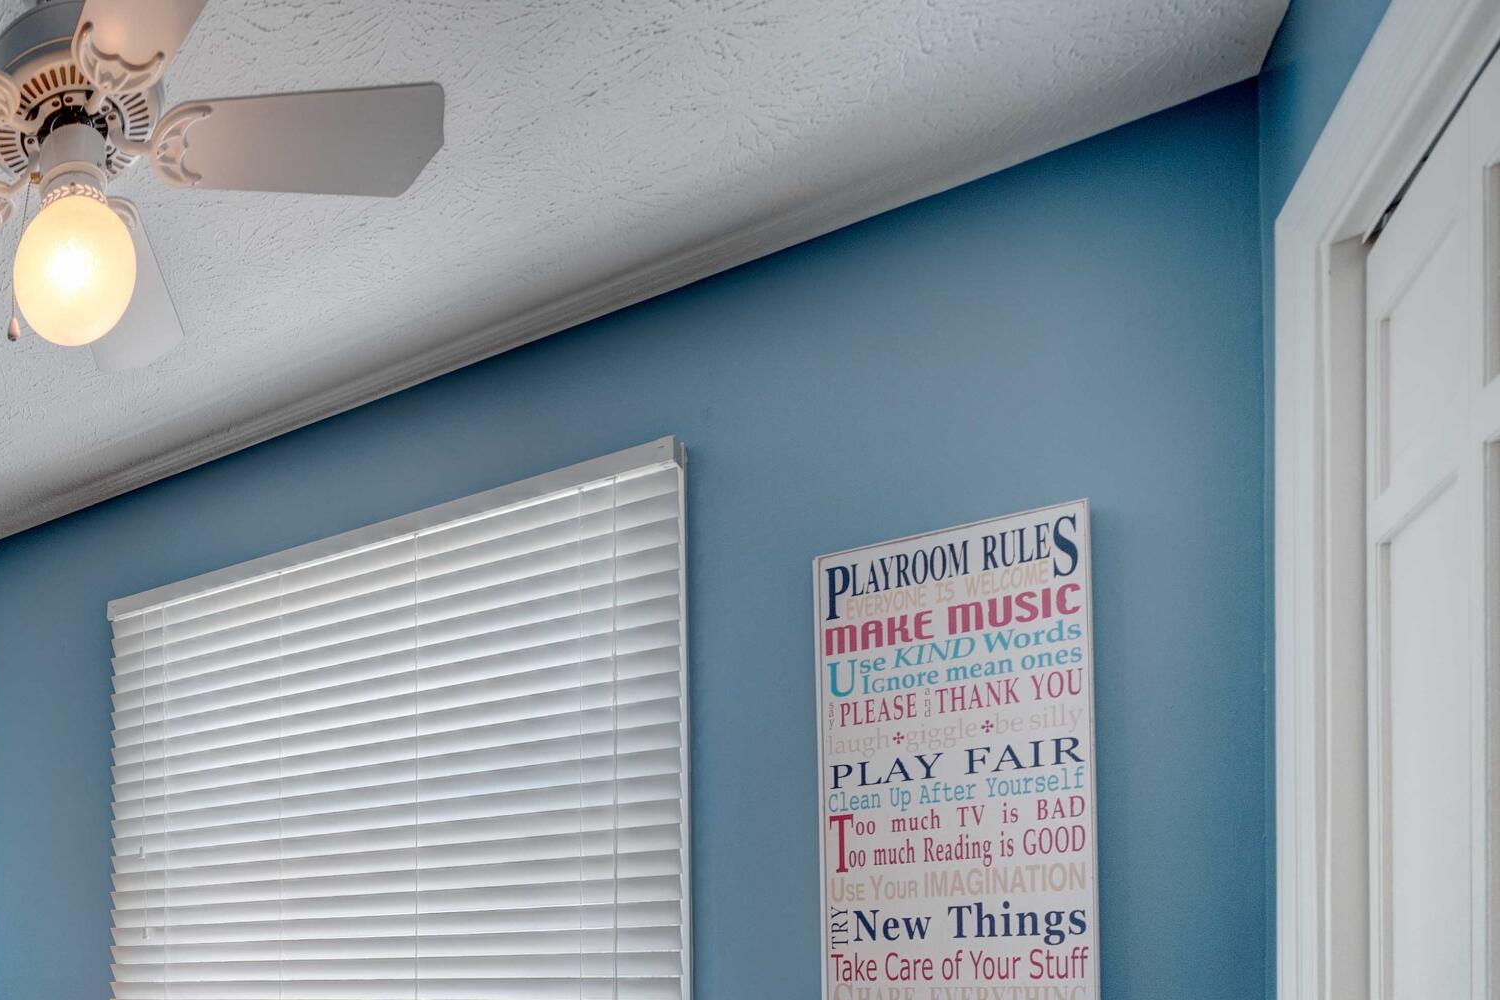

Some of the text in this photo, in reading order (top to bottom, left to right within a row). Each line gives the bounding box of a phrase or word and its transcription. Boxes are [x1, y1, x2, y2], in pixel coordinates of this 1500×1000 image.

[825, 514, 1078, 620] PLAYROOM RULES
[846, 560, 1049, 620] EVERYONE IS WELCOME
[827, 619, 1082, 698] Use KIND Words
[946, 657, 1013, 682] mean
[1020, 646, 1082, 670] ones
[840, 693, 916, 727] PLEASE
[935, 677, 1020, 714] THANK
[1030, 668, 1083, 701] YOU
[826, 703, 1083, 759] laugh giggle be silly
[829, 737, 1085, 790] PLAY FAIR
[828, 766, 1085, 813] Clean Up After Yourself
[891, 809, 940, 832] much
[956, 805, 985, 827] TV
[1002, 802, 1019, 824] is
[1036, 795, 1085, 821] BAD
[873, 838, 915, 865] much
[924, 834, 992, 867] Reading
[1000, 831, 1014, 857] is
[1023, 825, 1086, 856] GOOD
[924, 861, 1087, 898] IMAGINATION
[831, 901, 1087, 949] TRY New Things
[831, 946, 1089, 981] Take Care of Your Stuff
